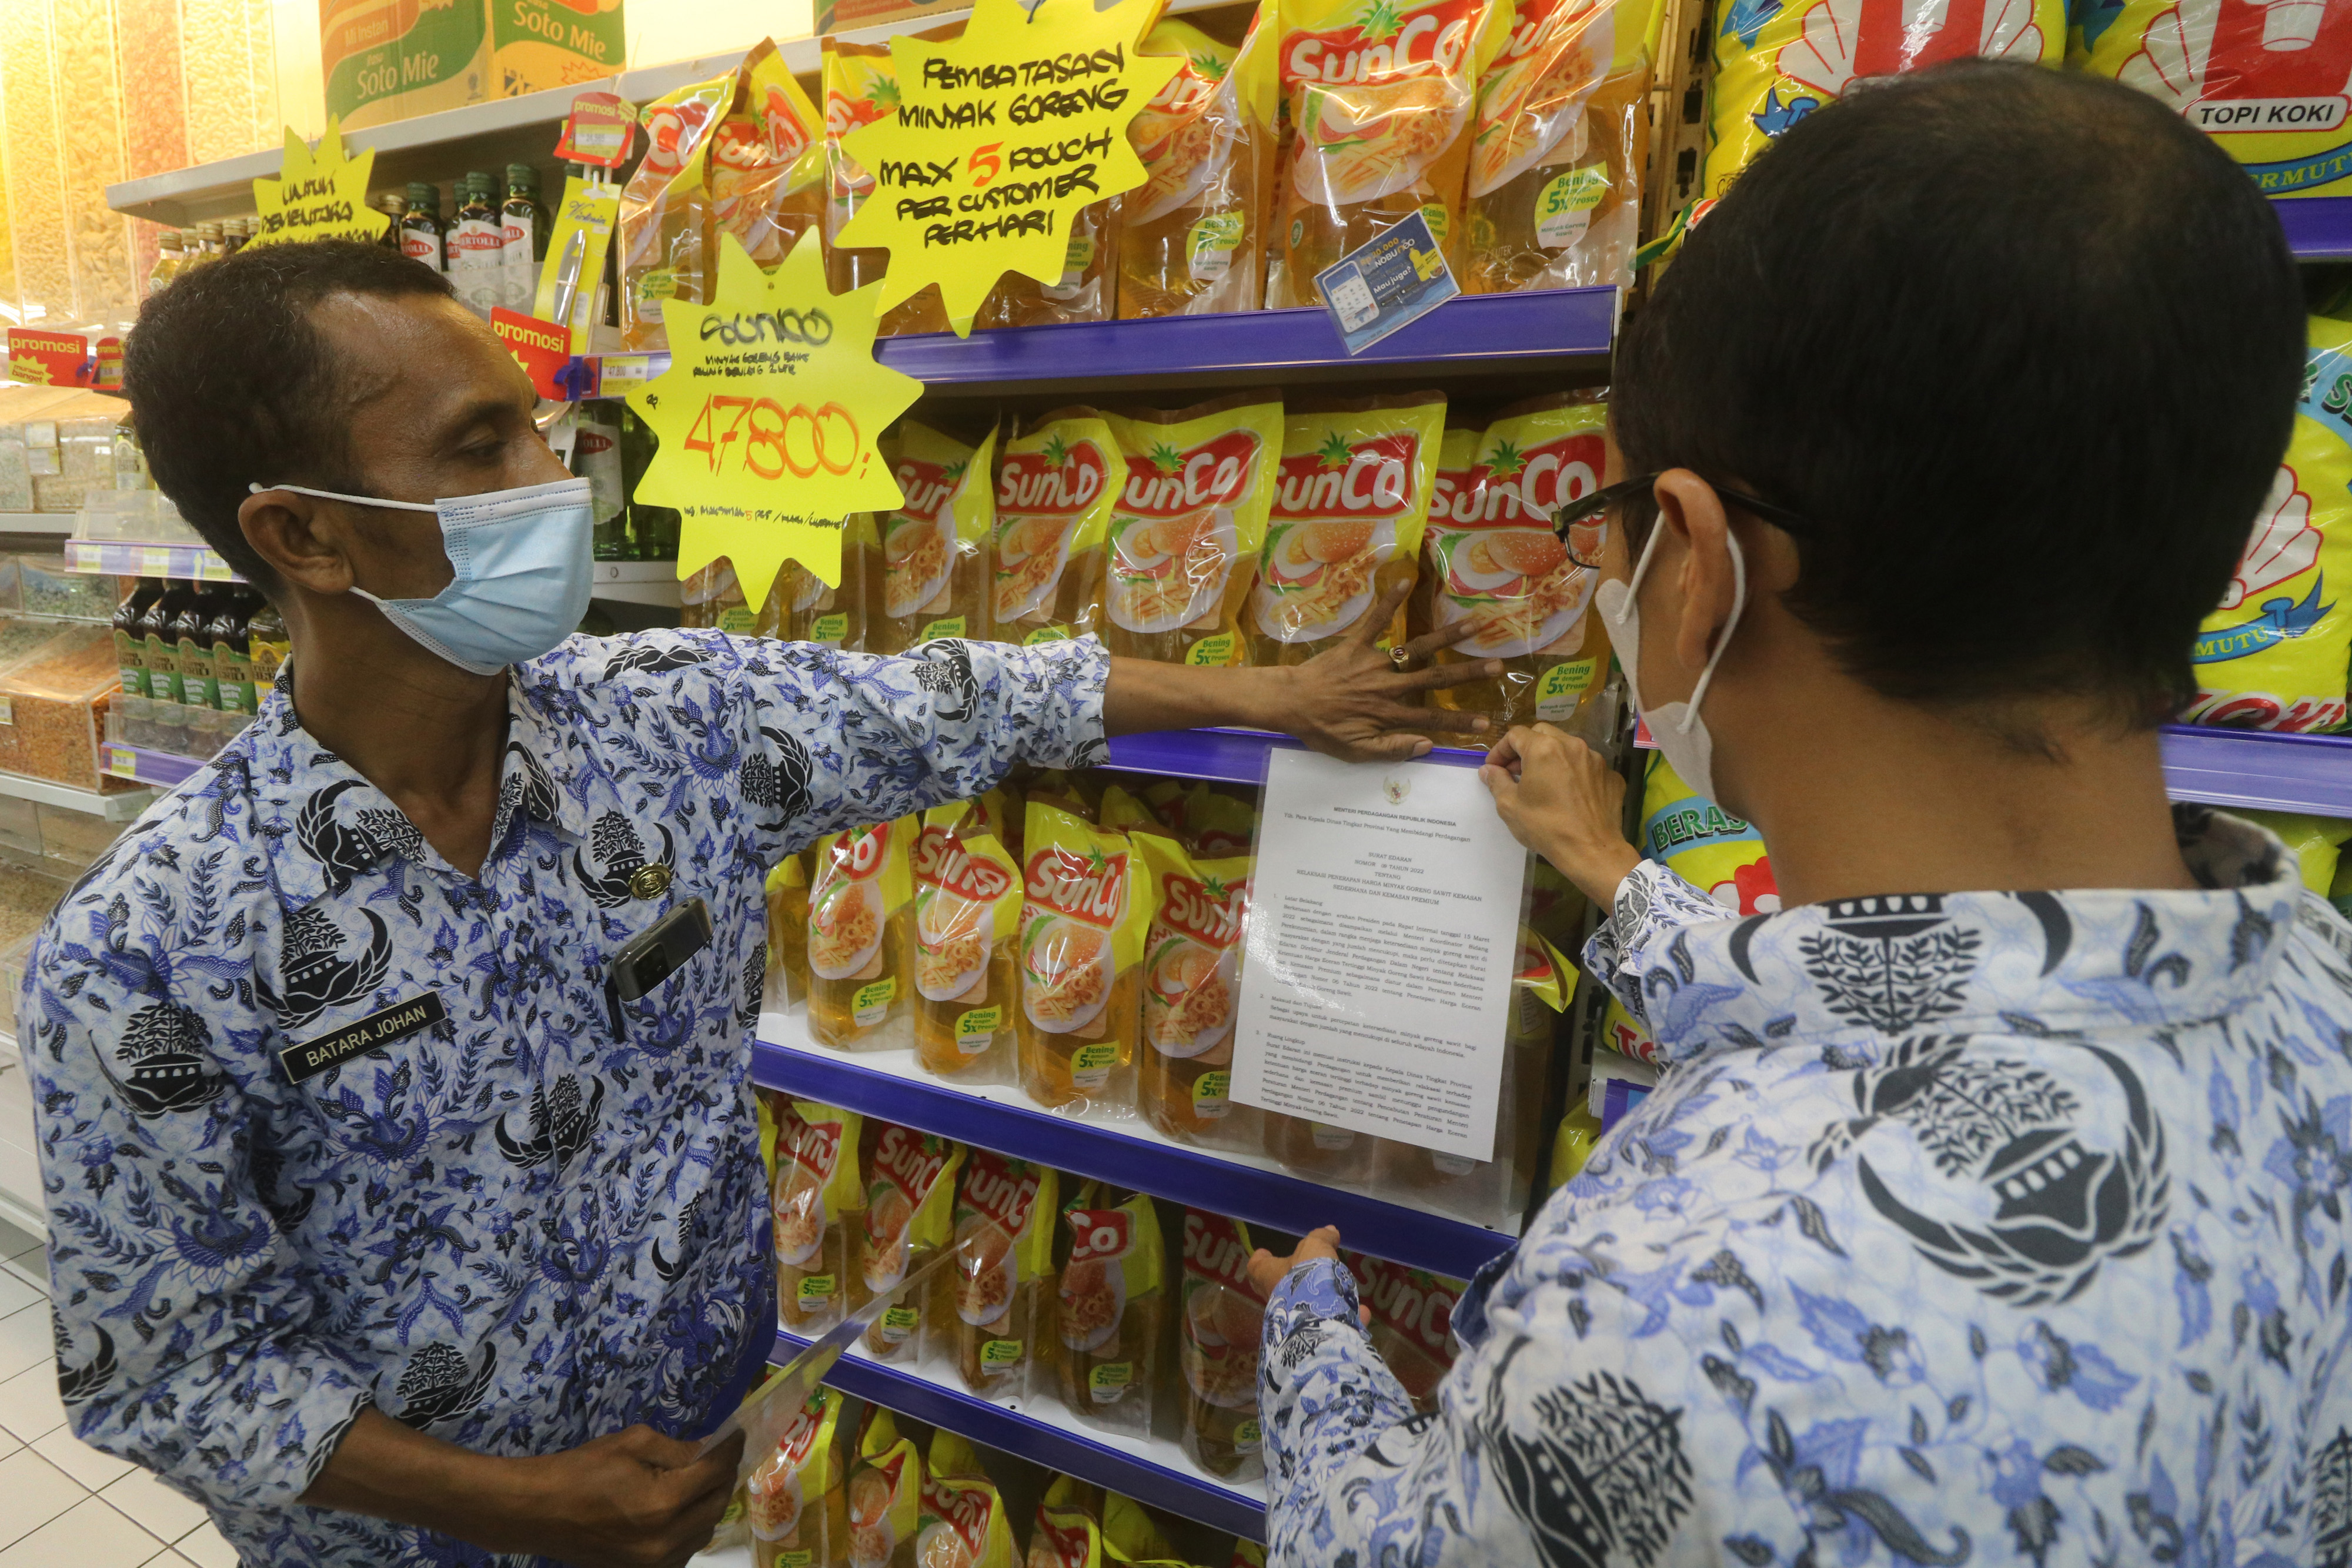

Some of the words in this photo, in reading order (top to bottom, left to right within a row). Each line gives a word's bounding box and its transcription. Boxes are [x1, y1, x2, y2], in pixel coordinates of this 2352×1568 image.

[359, 19, 388, 39] Instan
[513, 1, 564, 41] Soto
[569, 24, 606, 61] Mie
[1287, 14, 1469, 83] SunCo
[923, 42, 1125, 89] PEMBATASAN
[357, 65, 397, 99] Soto
[403, 51, 439, 85] Mie
[574, 101, 616, 116] promosi
[898, 99, 996, 129] MINYAK
[1008, 78, 1129, 125] GORENG
[2200, 106, 2261, 124] TOPI
[2267, 105, 2334, 123] KOKI
[880, 157, 960, 188] MAX
[968, 142, 1004, 187] 5
[1009, 127, 1113, 171] POUCH
[1558, 174, 1598, 188] Bening
[897, 198, 953, 221] PER
[958, 163, 1099, 212] CUSTOMER
[1571, 195, 1599, 205] Proses
[1546, 190, 1568, 213] 5x
[1423, 207, 1445, 220] Bening
[1373, 279, 1391, 294] Mau
[1389, 266, 1411, 287] juga?
[10, 337, 80, 353] promosi
[493, 319, 564, 354] promosi
[742, 352, 780, 364] GORENG
[12, 370, 42, 383] banget
[769, 363, 777, 374] 2
[897, 466, 953, 514] Sun
[1118, 452, 1240, 511] unCo
[1430, 452, 1598, 523] SunCo
[745, 510, 753, 520] 5
[933, 623, 960, 631] Bening
[1202, 638, 1231, 650] Bening
[2194, 626, 2269, 657] MUTU
[1194, 649, 1211, 665] 5x
[1557, 665, 1590, 675] Bening
[1546, 677, 1565, 694] 5x
[1357, 810, 1398, 819] PERDAGANGAN
[1426, 818, 1456, 827] INDONESIA
[1401, 828, 1434, 838] Membidangi
[1435, 833, 1471, 842] Perdagangan
[1374, 872, 1401, 880] TENTANG
[1297, 869, 1326, 878] RELAKSASI
[1328, 874, 1361, 883] PENERAPAN
[1453, 892, 1482, 901] KEMASAN
[1299, 898, 1323, 906] Belakang
[1333, 884, 1367, 894] SEDERHANA
[1411, 897, 1439, 905] PREMIUM
[1284, 904, 1310, 912] Berkenaan
[1358, 916, 1380, 924] Presiden
[1300, 917, 1334, 926] sebagaimana
[1339, 922, 1372, 932] disampaikan
[1429, 937, 1463, 947] Koordinator
[1468, 944, 1489, 953] Bidang
[865, 982, 891, 993] Bening
[859, 994, 873, 1007] 5x
[963, 1019, 977, 1033] 5x
[1330, 1017, 1359, 1027] percepatan
[1363, 1024, 1396, 1034] ketersediaan
[1400, 1031, 1421, 1039] minyak
[306, 1029, 373, 1067] BATARA
[375, 1005, 427, 1038] JOHAN
[1079, 1054, 1094, 1068] 5x
[1201, 1081, 1217, 1096] 5x
[878, 1127, 942, 1199] SunC
[965, 1158, 1038, 1227] SunC
[1183, 1213, 1253, 1284] Sun
[803, 1283, 814, 1295] 5x
[987, 1348, 999, 1360] 5x
[1095, 1372, 1109, 1385] 5x
